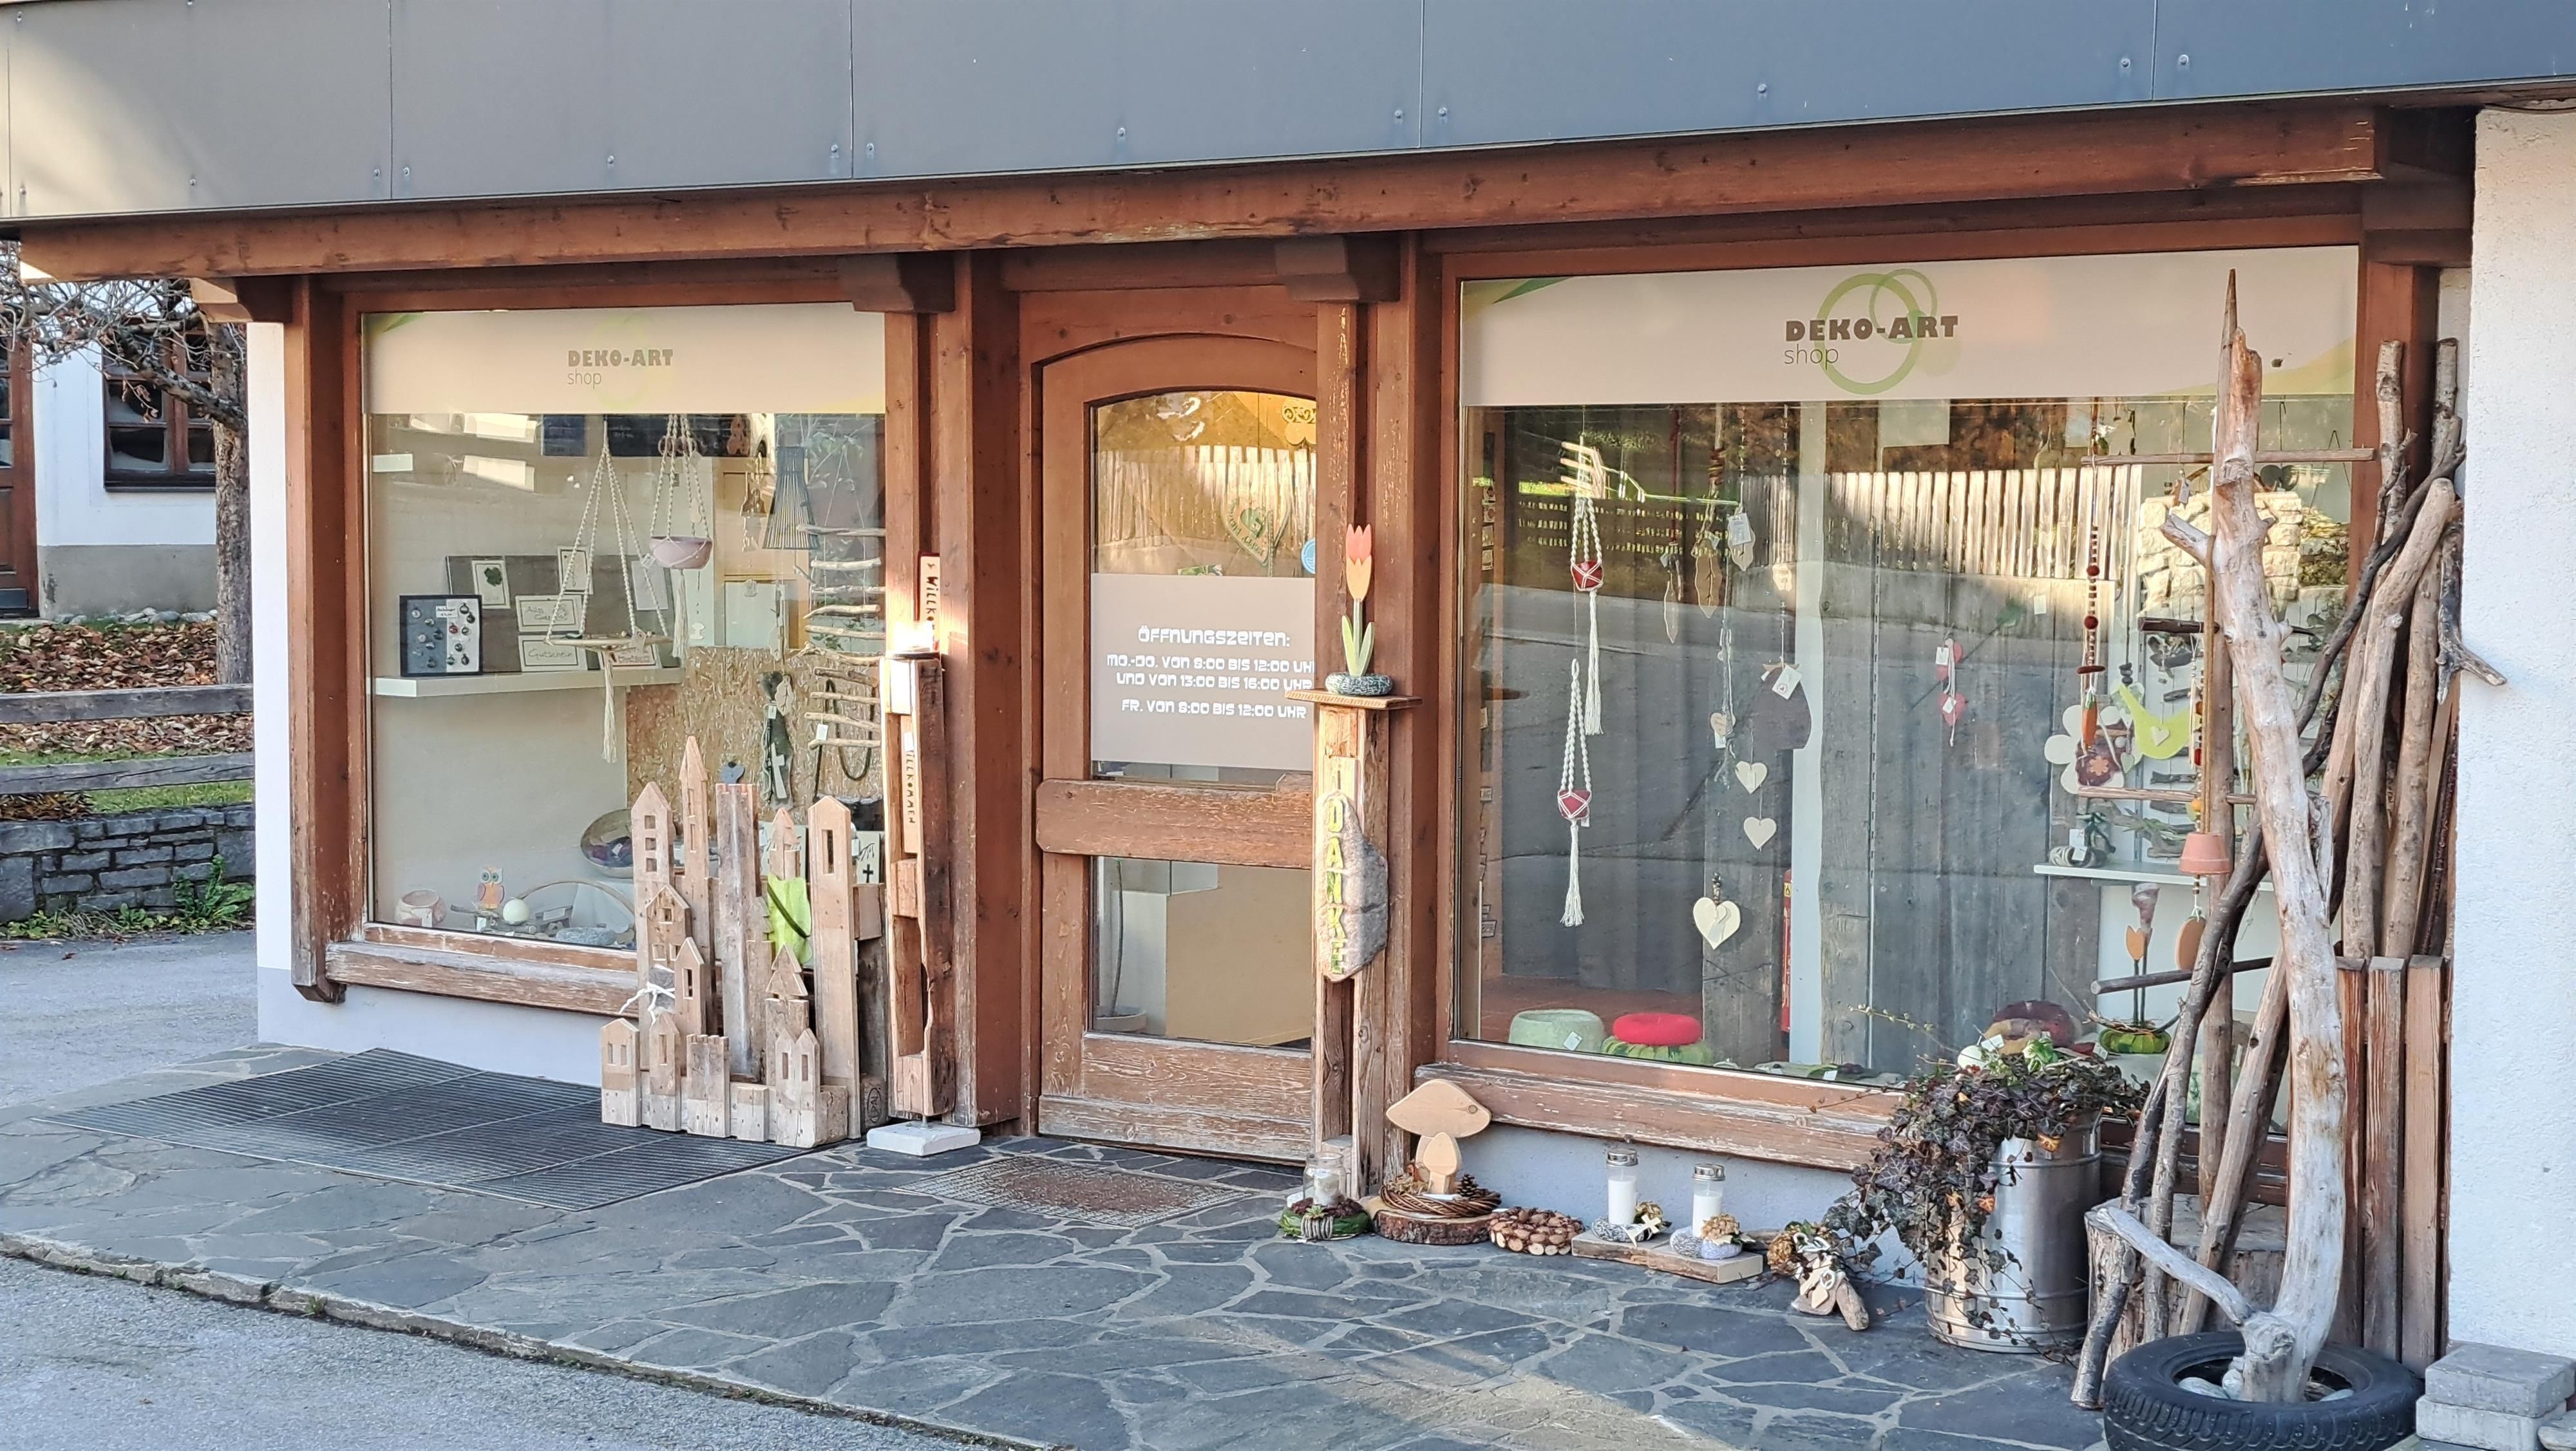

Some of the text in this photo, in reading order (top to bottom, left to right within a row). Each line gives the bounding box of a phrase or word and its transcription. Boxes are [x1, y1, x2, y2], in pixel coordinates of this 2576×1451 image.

[1785, 316, 1958, 341] DEKO-ART
[568, 349, 673, 367] DEKO-ART
[1783, 343, 1839, 370] shop
[567, 369, 601, 389] shop
[1162, 656, 1189, 669] VON
[1193, 657, 1225, 670] 8:00
[1228, 658, 1250, 671] BIS
[1254, 659, 1289, 672] 12:00
[1116, 672, 1312, 691] UND VON 13:00 BIS 16:00 UHR
[1122, 699, 1307, 719] FR. VON 8:00 BIS 12:00 UHR
[1325, 799, 1347, 974] DANKE
